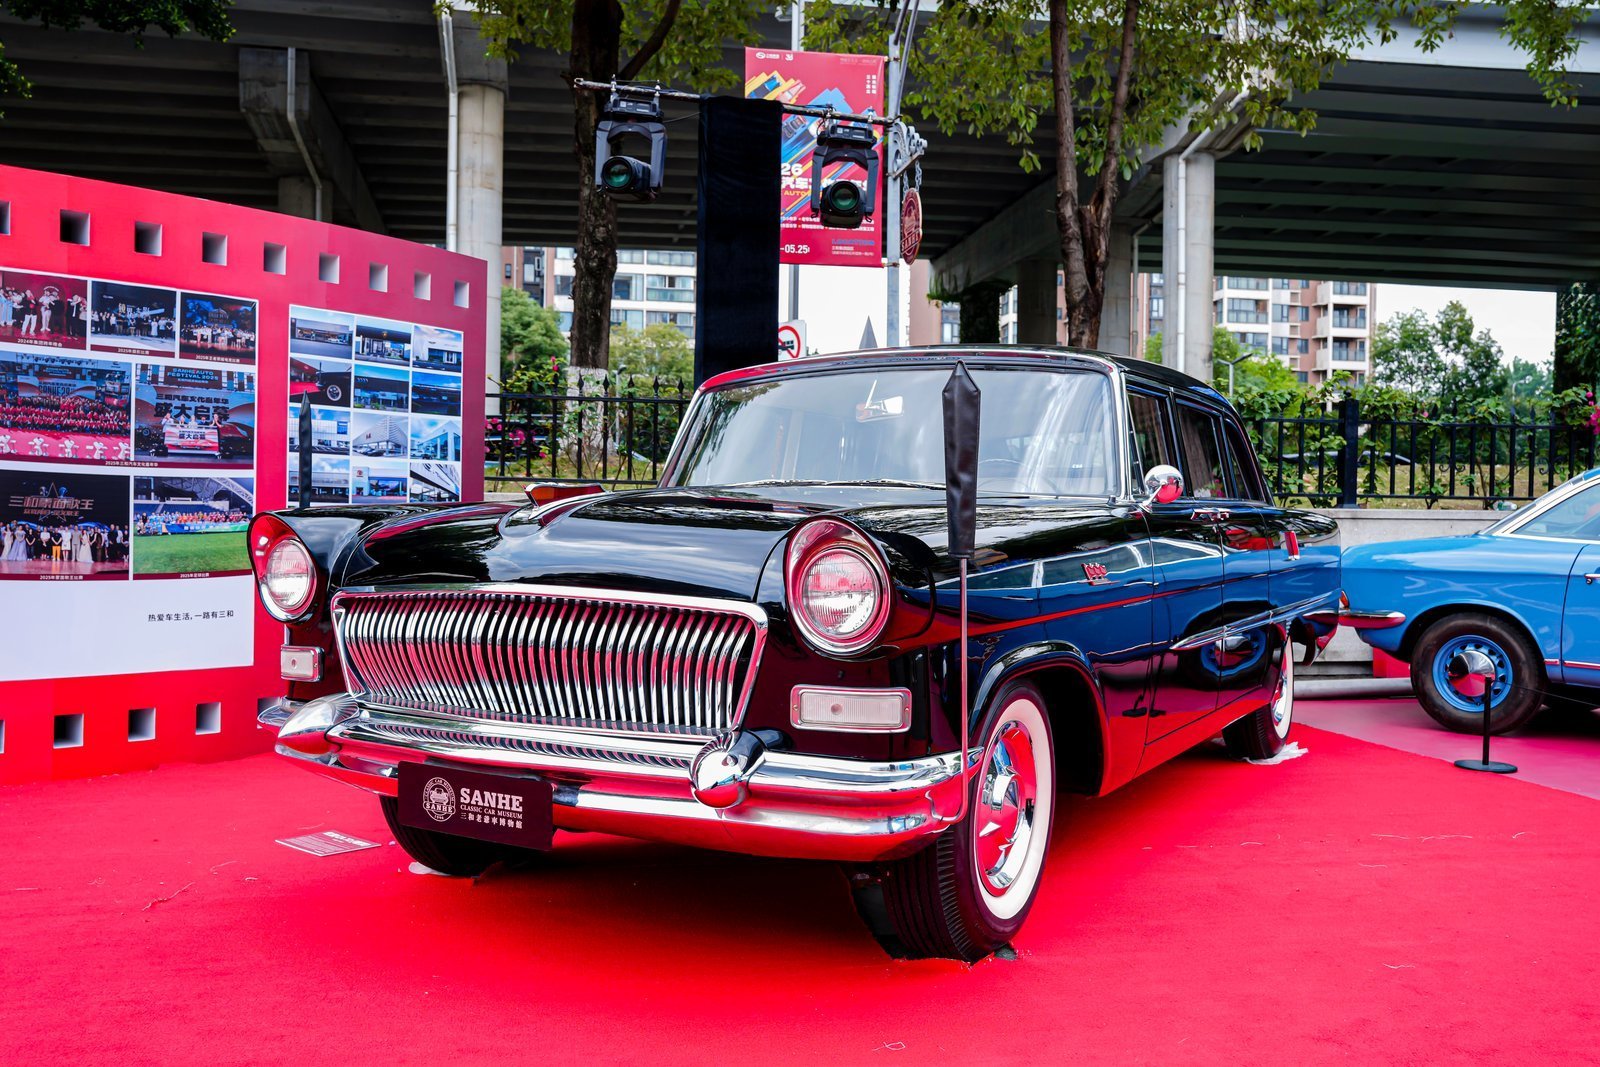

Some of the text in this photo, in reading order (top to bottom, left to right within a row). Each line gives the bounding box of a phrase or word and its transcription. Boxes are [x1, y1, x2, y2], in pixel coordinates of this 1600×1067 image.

[425, 802, 453, 813] SANHE
[460, 787, 523, 812] SANHE
[460, 804, 482, 813] CLASSIC
[497, 810, 523, 820] MUSEUM
